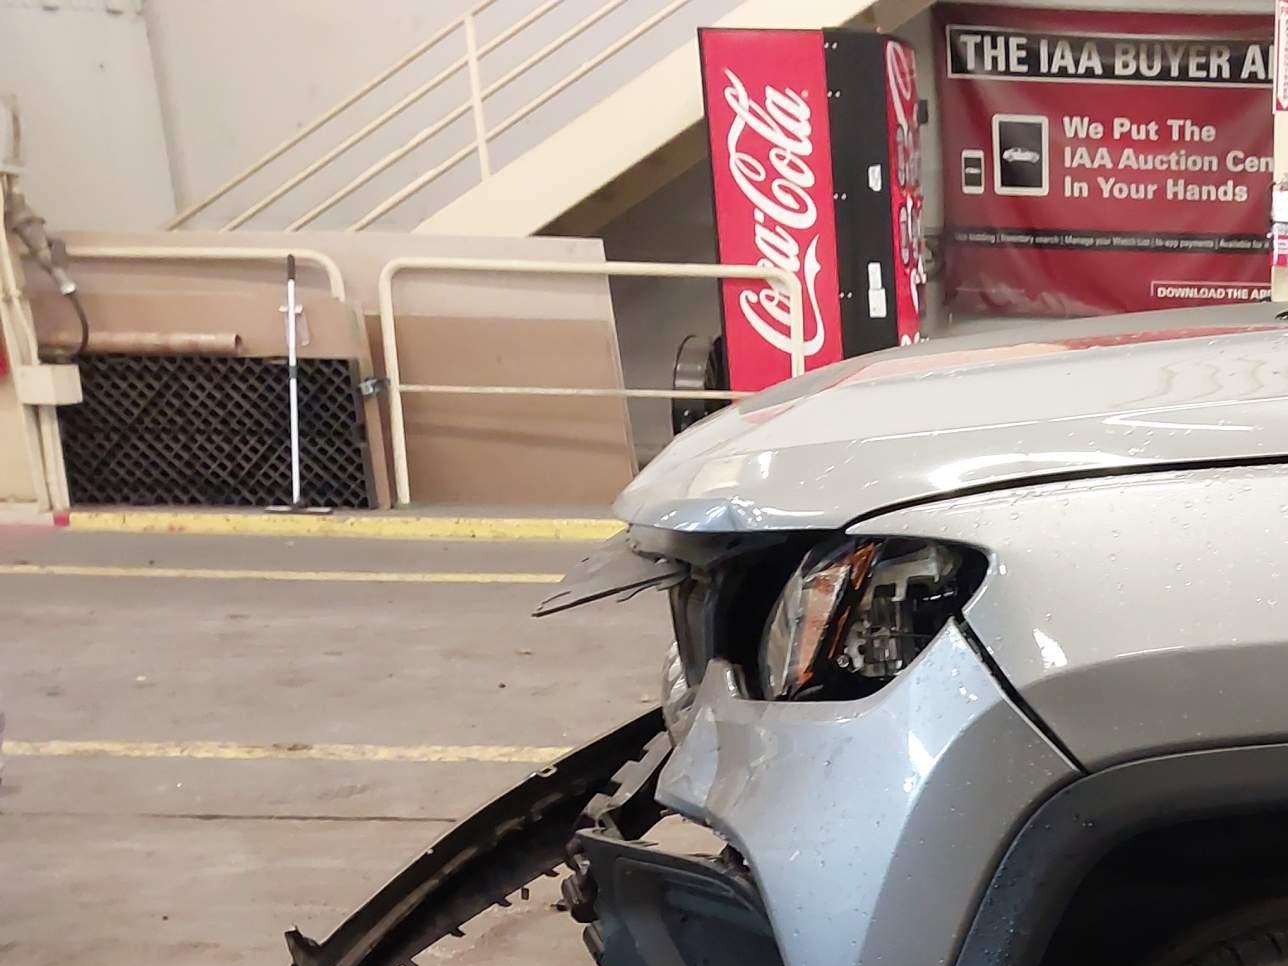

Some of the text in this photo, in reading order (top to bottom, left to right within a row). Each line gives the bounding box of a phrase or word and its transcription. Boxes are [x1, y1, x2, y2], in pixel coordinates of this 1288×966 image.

[960, 34, 1029, 73] THE
[1039, 39, 1103, 75] IAA
[1114, 43, 1230, 79] BUYER
[1063, 116, 1216, 142] We Put The
[1064, 146, 1113, 169] IAA
[1118, 148, 1218, 172] Auction
[1064, 175, 1248, 202] In Your Hands
[1157, 287, 1225, 299] DOWNLOAD
[1227, 288, 1248, 299] THE
